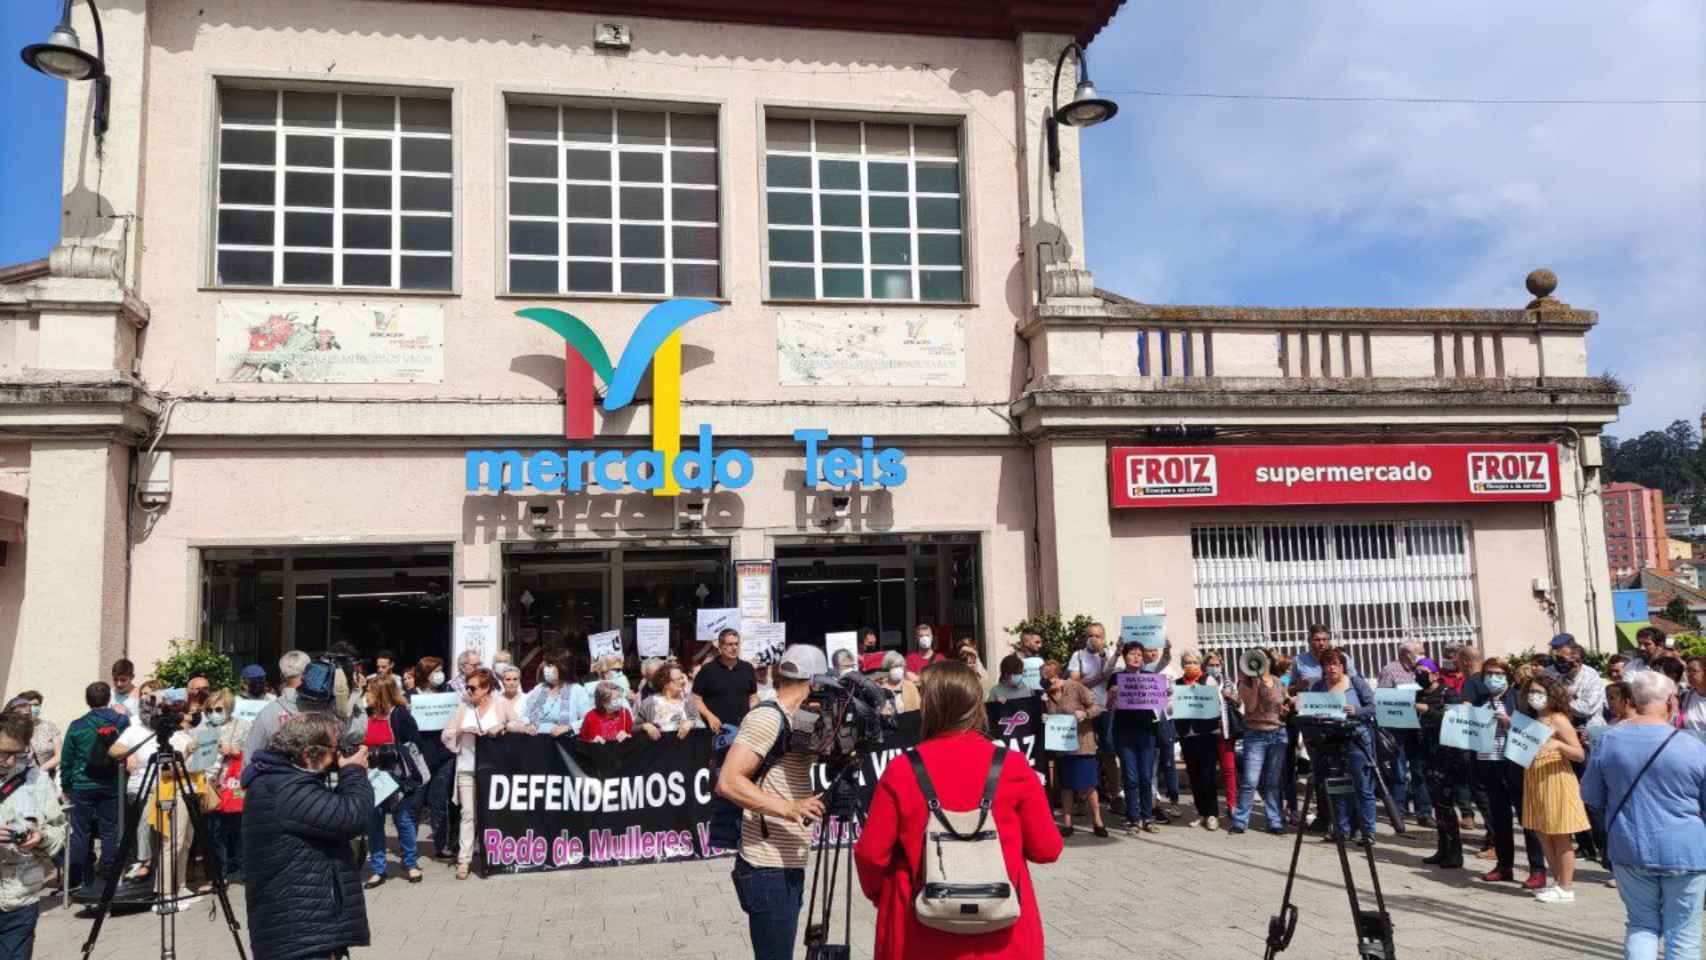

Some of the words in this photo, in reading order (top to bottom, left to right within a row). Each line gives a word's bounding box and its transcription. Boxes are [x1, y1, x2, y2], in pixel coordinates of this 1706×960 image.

[465, 423, 754, 492] mercado
[793, 428, 907, 488] Teis
[1131, 457, 1211, 484] FROIZ
[1255, 461, 1432, 487] supermercado
[1472, 455, 1544, 480] FROIZ
[488, 771, 686, 813] DEFENDEMOS
[694, 768, 711, 804] C
[484, 828, 548, 865] Rede
[552, 829, 584, 866] de
[588, 825, 694, 862] Mulleres
